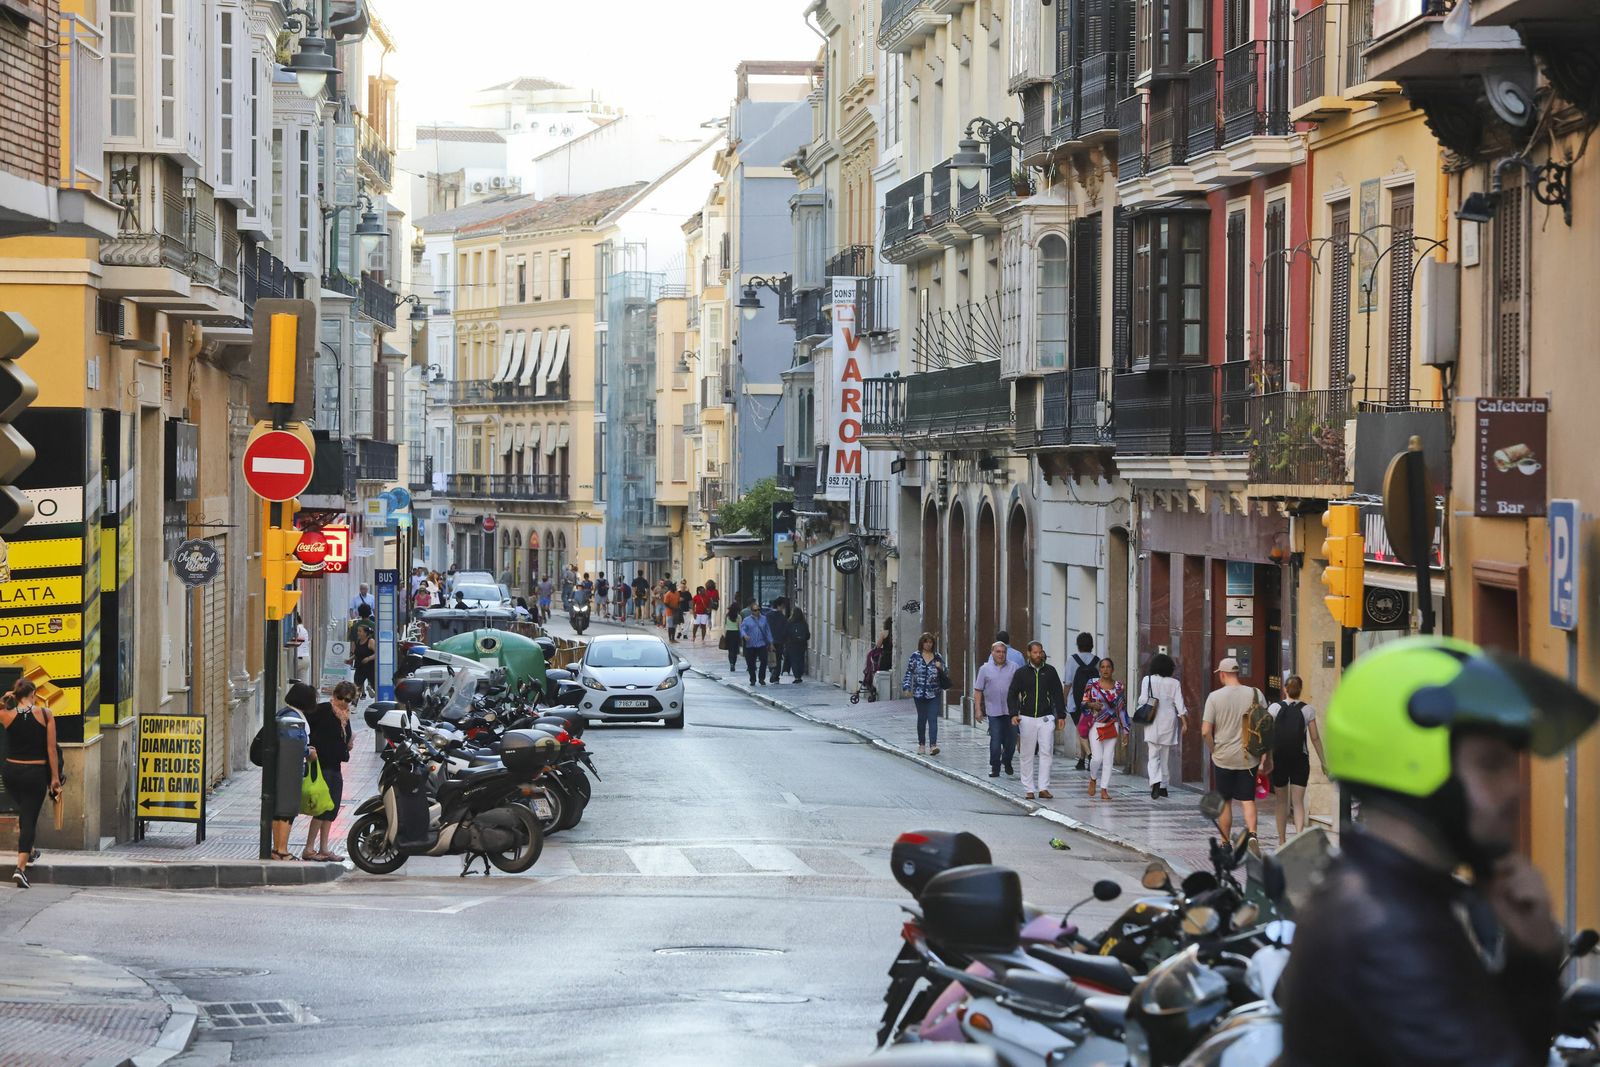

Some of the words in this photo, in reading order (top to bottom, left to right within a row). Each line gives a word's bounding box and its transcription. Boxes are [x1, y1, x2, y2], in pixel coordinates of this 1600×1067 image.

[828, 476, 840, 485] 952
[841, 477, 849, 485] 72
[1496, 501, 1525, 514] Bar
[378, 572, 393, 583] BUS
[142, 718, 202, 735] COMPRAMOS
[141, 738, 201, 755] DIAMANTES
[141, 757, 149, 773] Y
[154, 758, 201, 774] RELOJES
[140, 777, 166, 792] ALTA
[168, 777, 200, 793] GAMA
